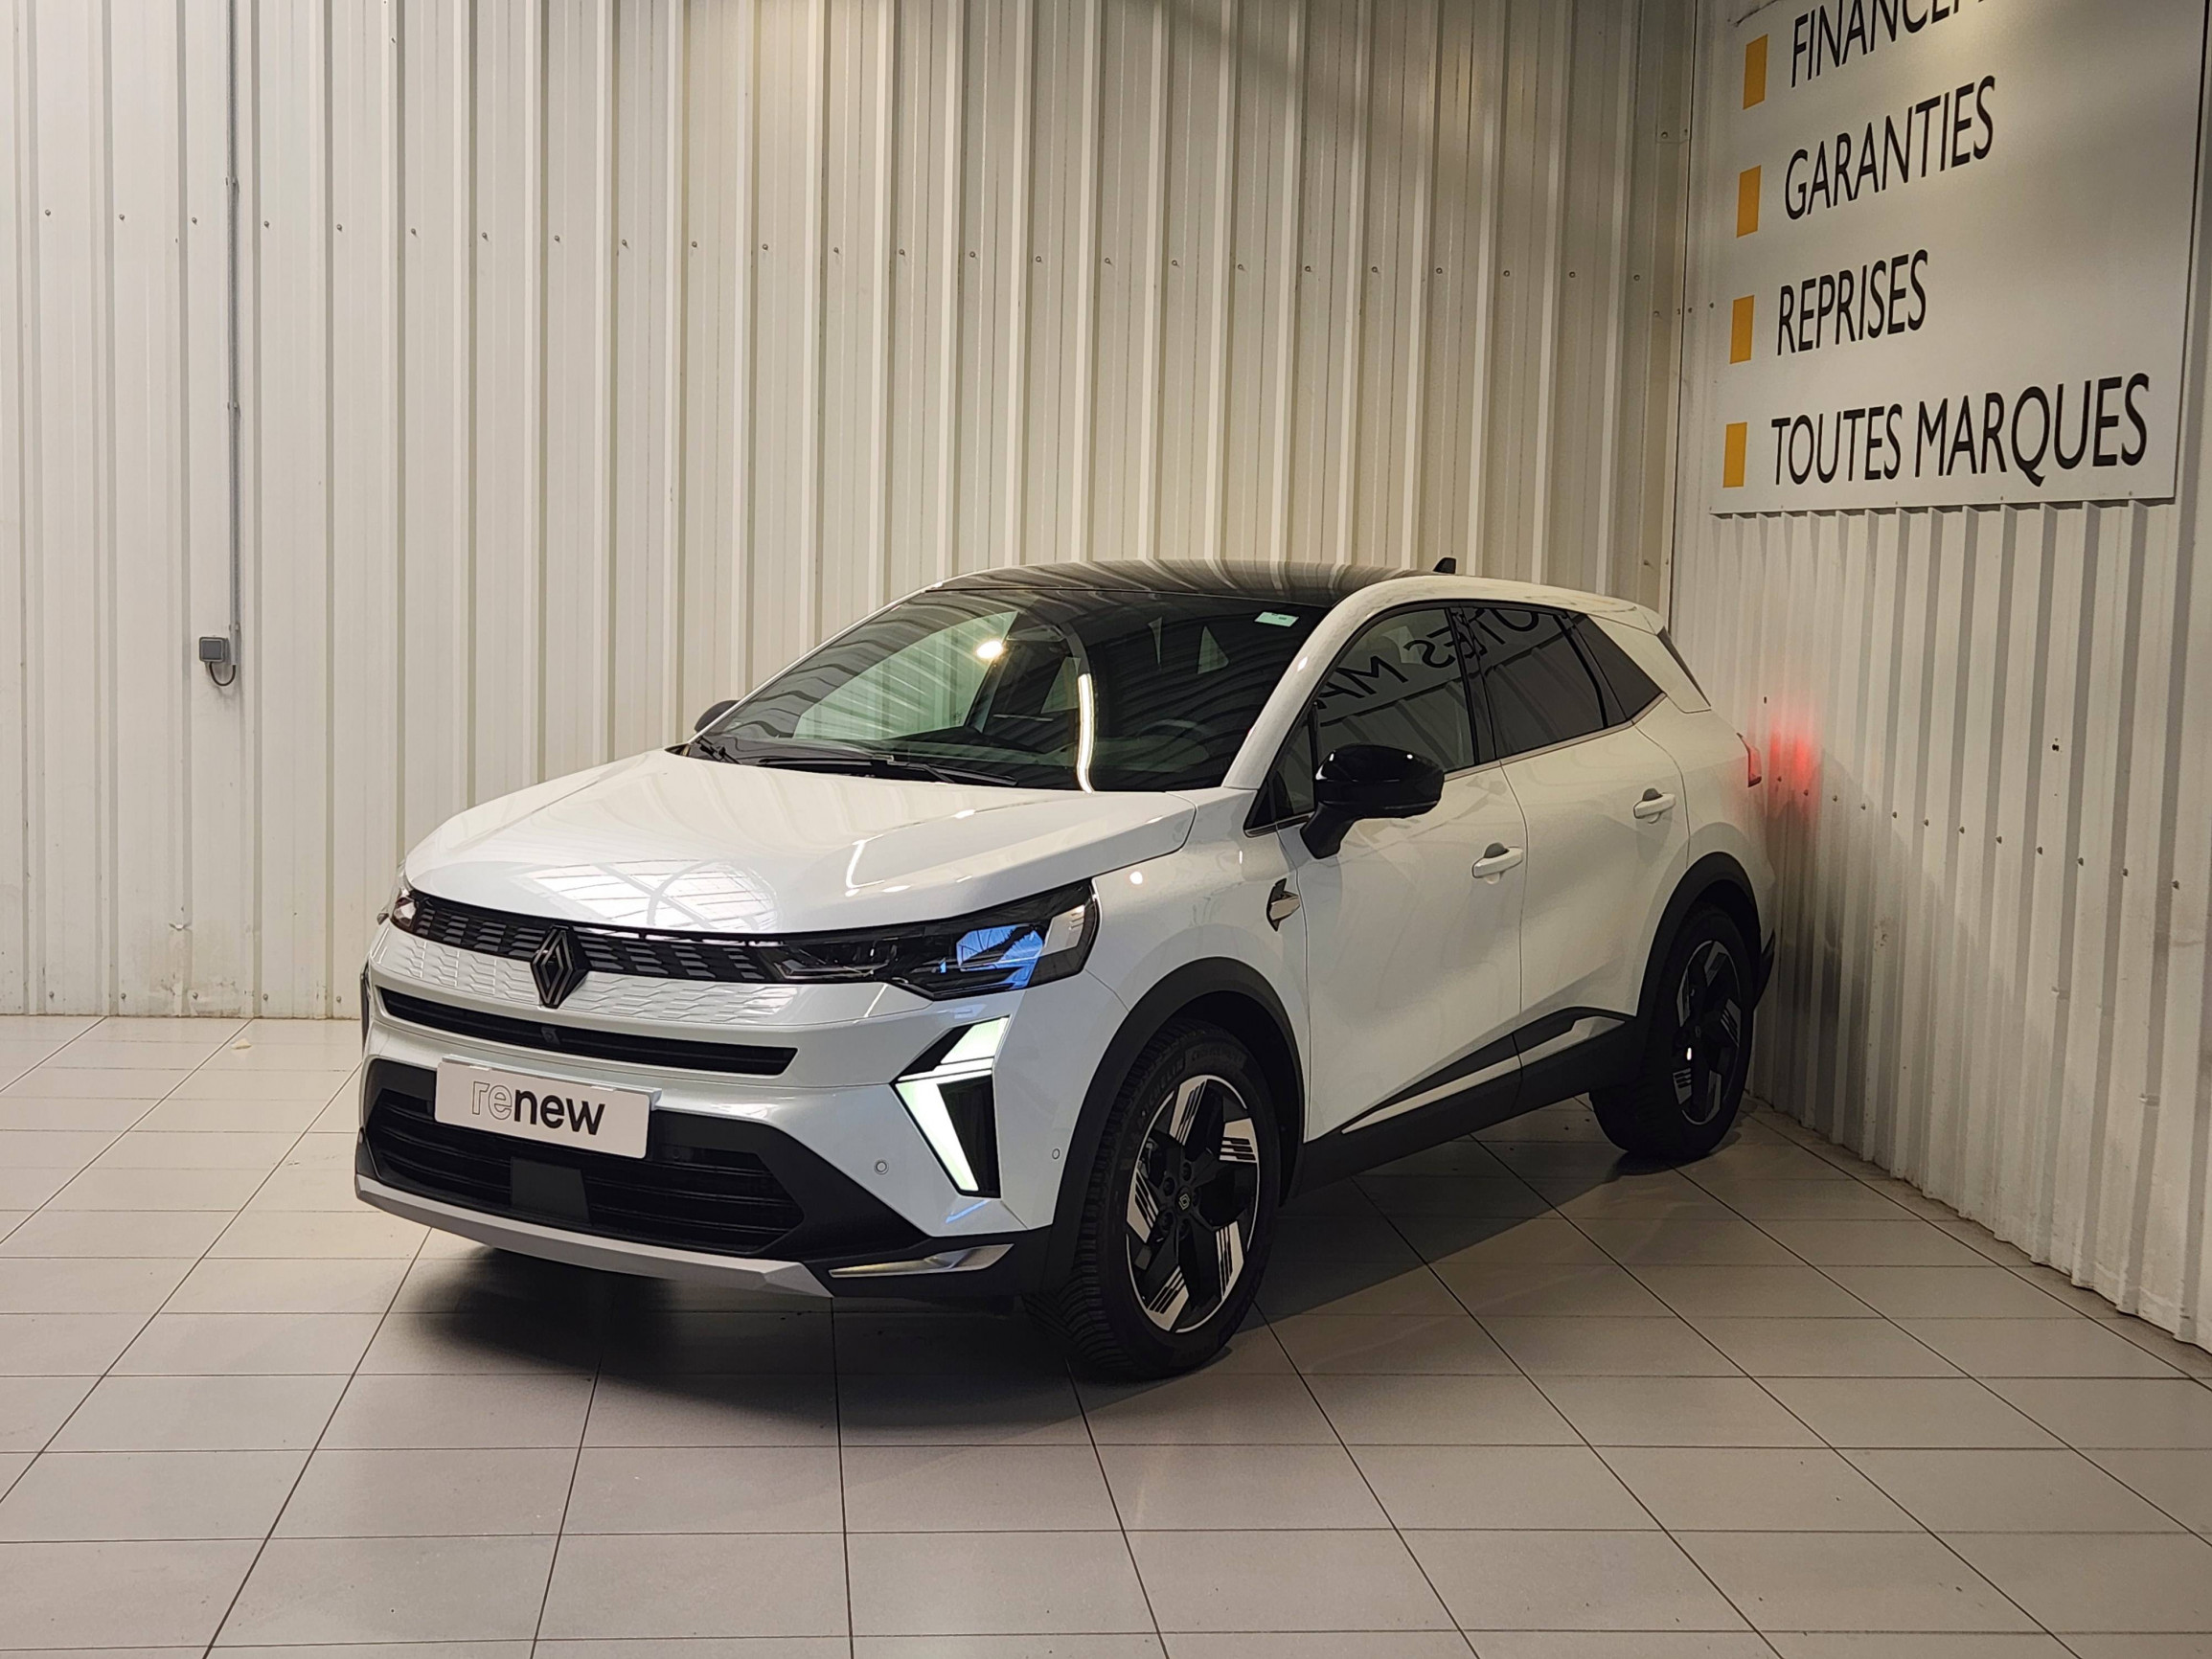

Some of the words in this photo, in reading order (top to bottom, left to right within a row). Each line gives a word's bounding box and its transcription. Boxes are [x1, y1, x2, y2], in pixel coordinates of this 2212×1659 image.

[1790, 0, 1984, 88] FINAN
[1784, 75, 1995, 220] GARANTIES
[1777, 249, 1928, 356] REPRISES
[1770, 403, 1903, 486] TOUTES
[1915, 373, 2150, 488] MARQUES
[471, 1080, 605, 1136] renew
